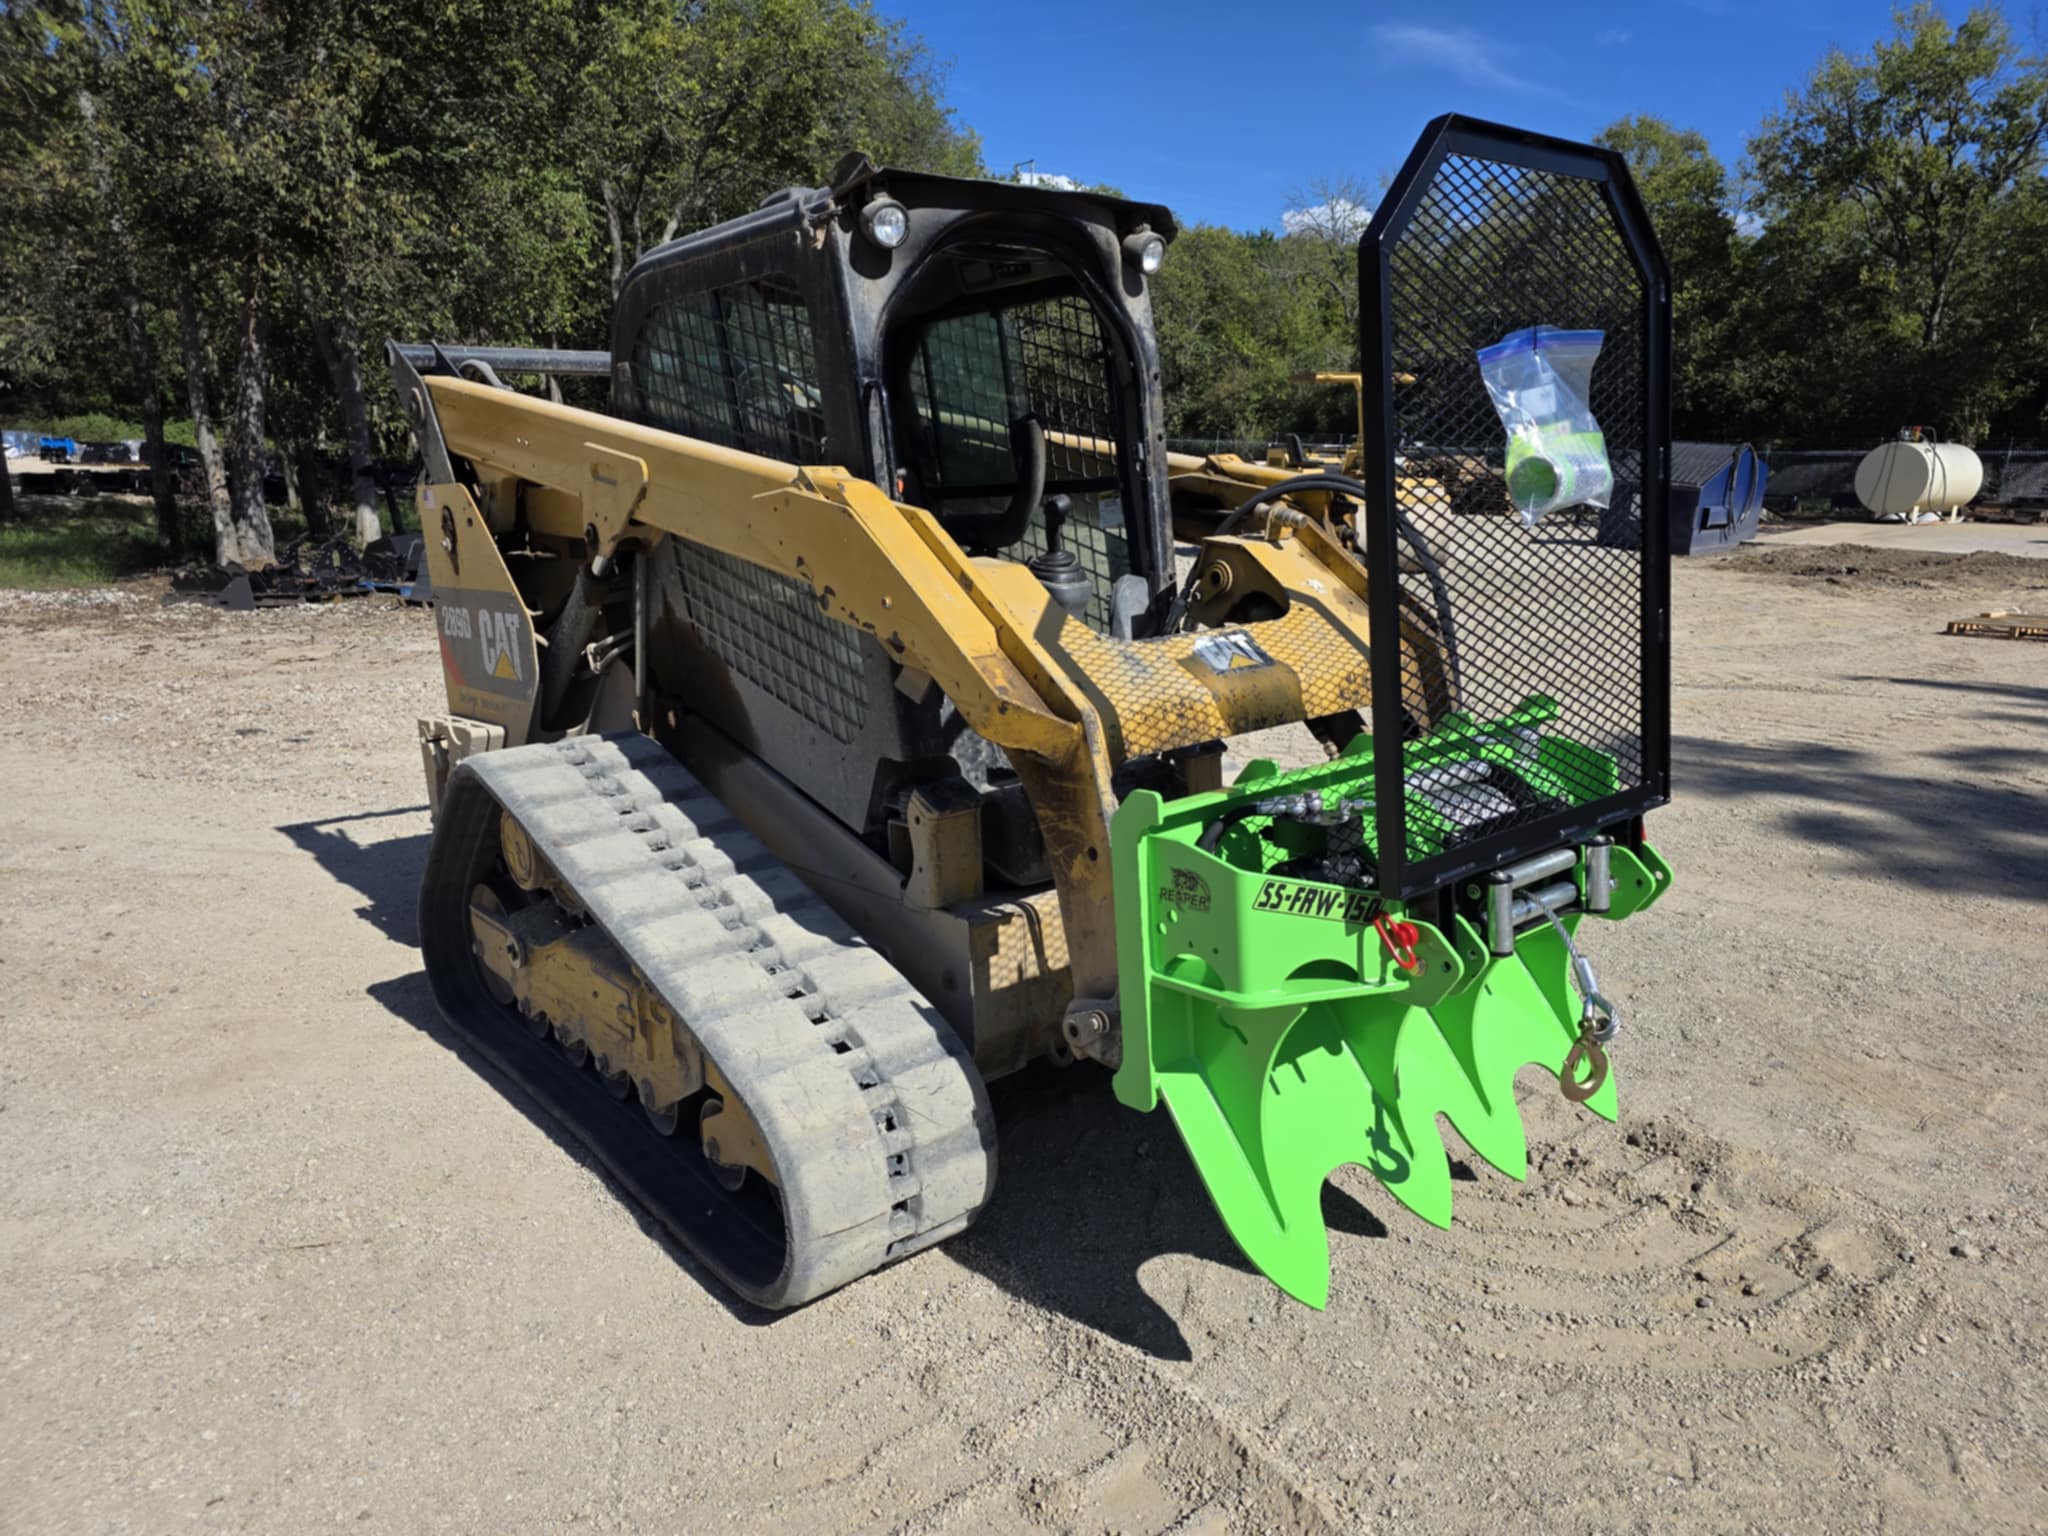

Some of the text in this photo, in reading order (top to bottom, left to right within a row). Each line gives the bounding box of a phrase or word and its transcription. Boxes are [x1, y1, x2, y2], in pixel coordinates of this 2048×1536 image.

[479, 608, 522, 680] CAT
[1160, 887, 1209, 908] REAPER
[1257, 882, 1382, 922] SS-FRW-150
